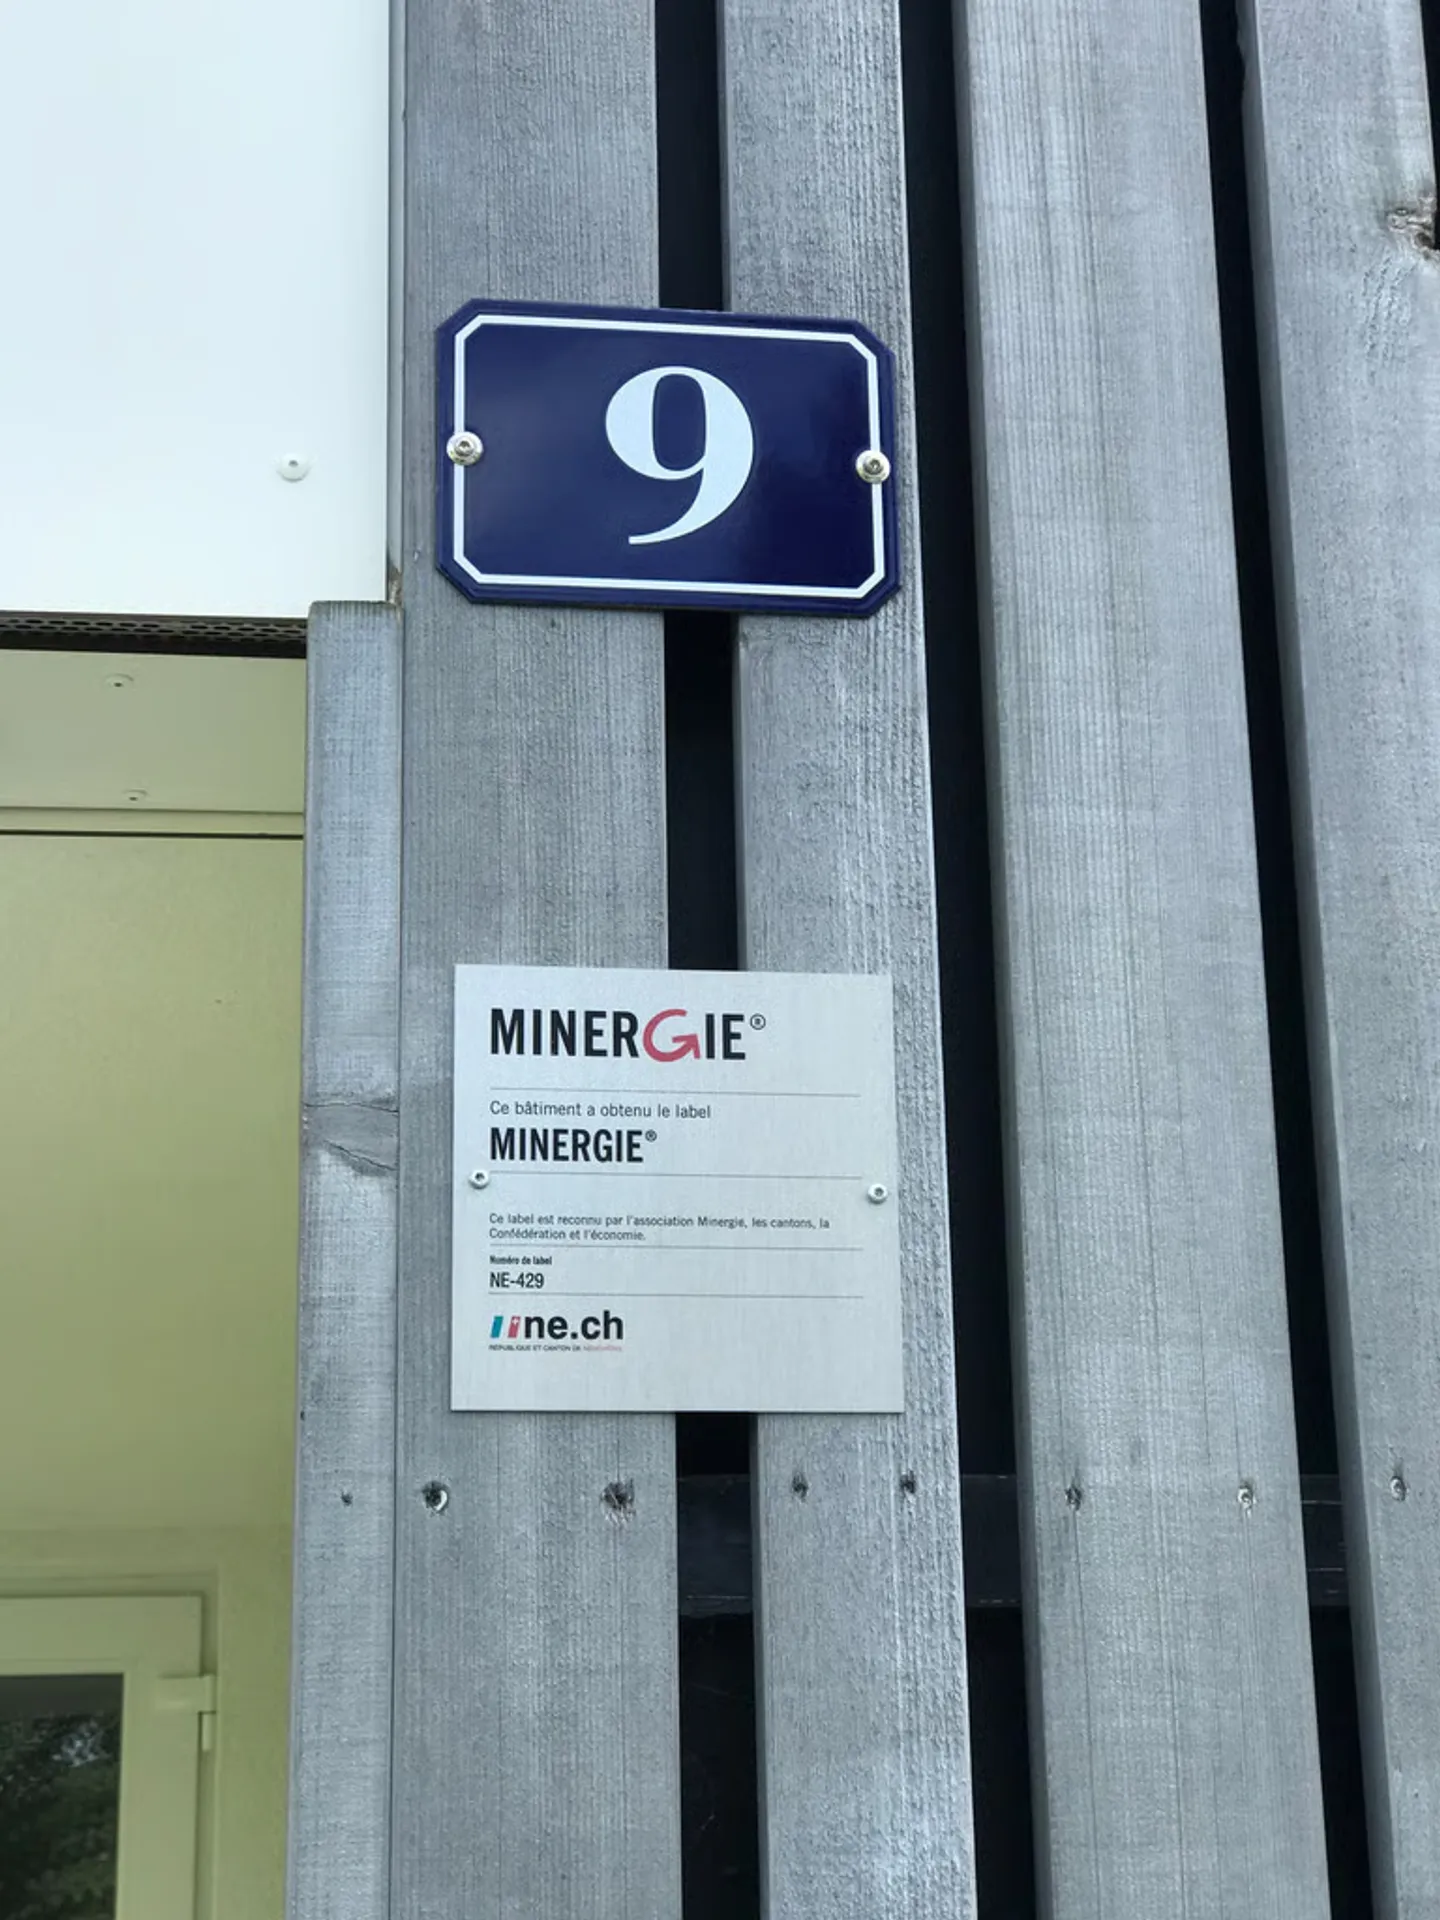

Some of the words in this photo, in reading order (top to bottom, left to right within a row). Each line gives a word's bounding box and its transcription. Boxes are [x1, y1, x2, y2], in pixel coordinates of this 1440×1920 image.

[605, 365, 754, 545] 9
[490, 1100, 509, 1115] Ce
[515, 1101, 582, 1117] bâtiment
[587, 1105, 595, 1117] a
[600, 1102, 651, 1117] obtenu
[657, 1103, 670, 1118] le
[676, 1104, 711, 1119] label
[489, 1213, 504, 1224] Ce
[508, 1213, 534, 1224] label
[537, 1215, 553, 1225] est
[557, 1216, 601, 1226] reconnu
[605, 1217, 623, 1228] par
[698, 1216, 748, 1229] Minergie,
[752, 1217, 767, 1228] les
[770, 1218, 816, 1230] cantons,
[820, 1218, 830, 1229] la
[489, 1227, 566, 1239] Confédération
[569, 1229, 580, 1240] et
[521, 1256, 532, 1265] de
[533, 1256, 552, 1266] label
[489, 1272, 545, 1289] NE-429
